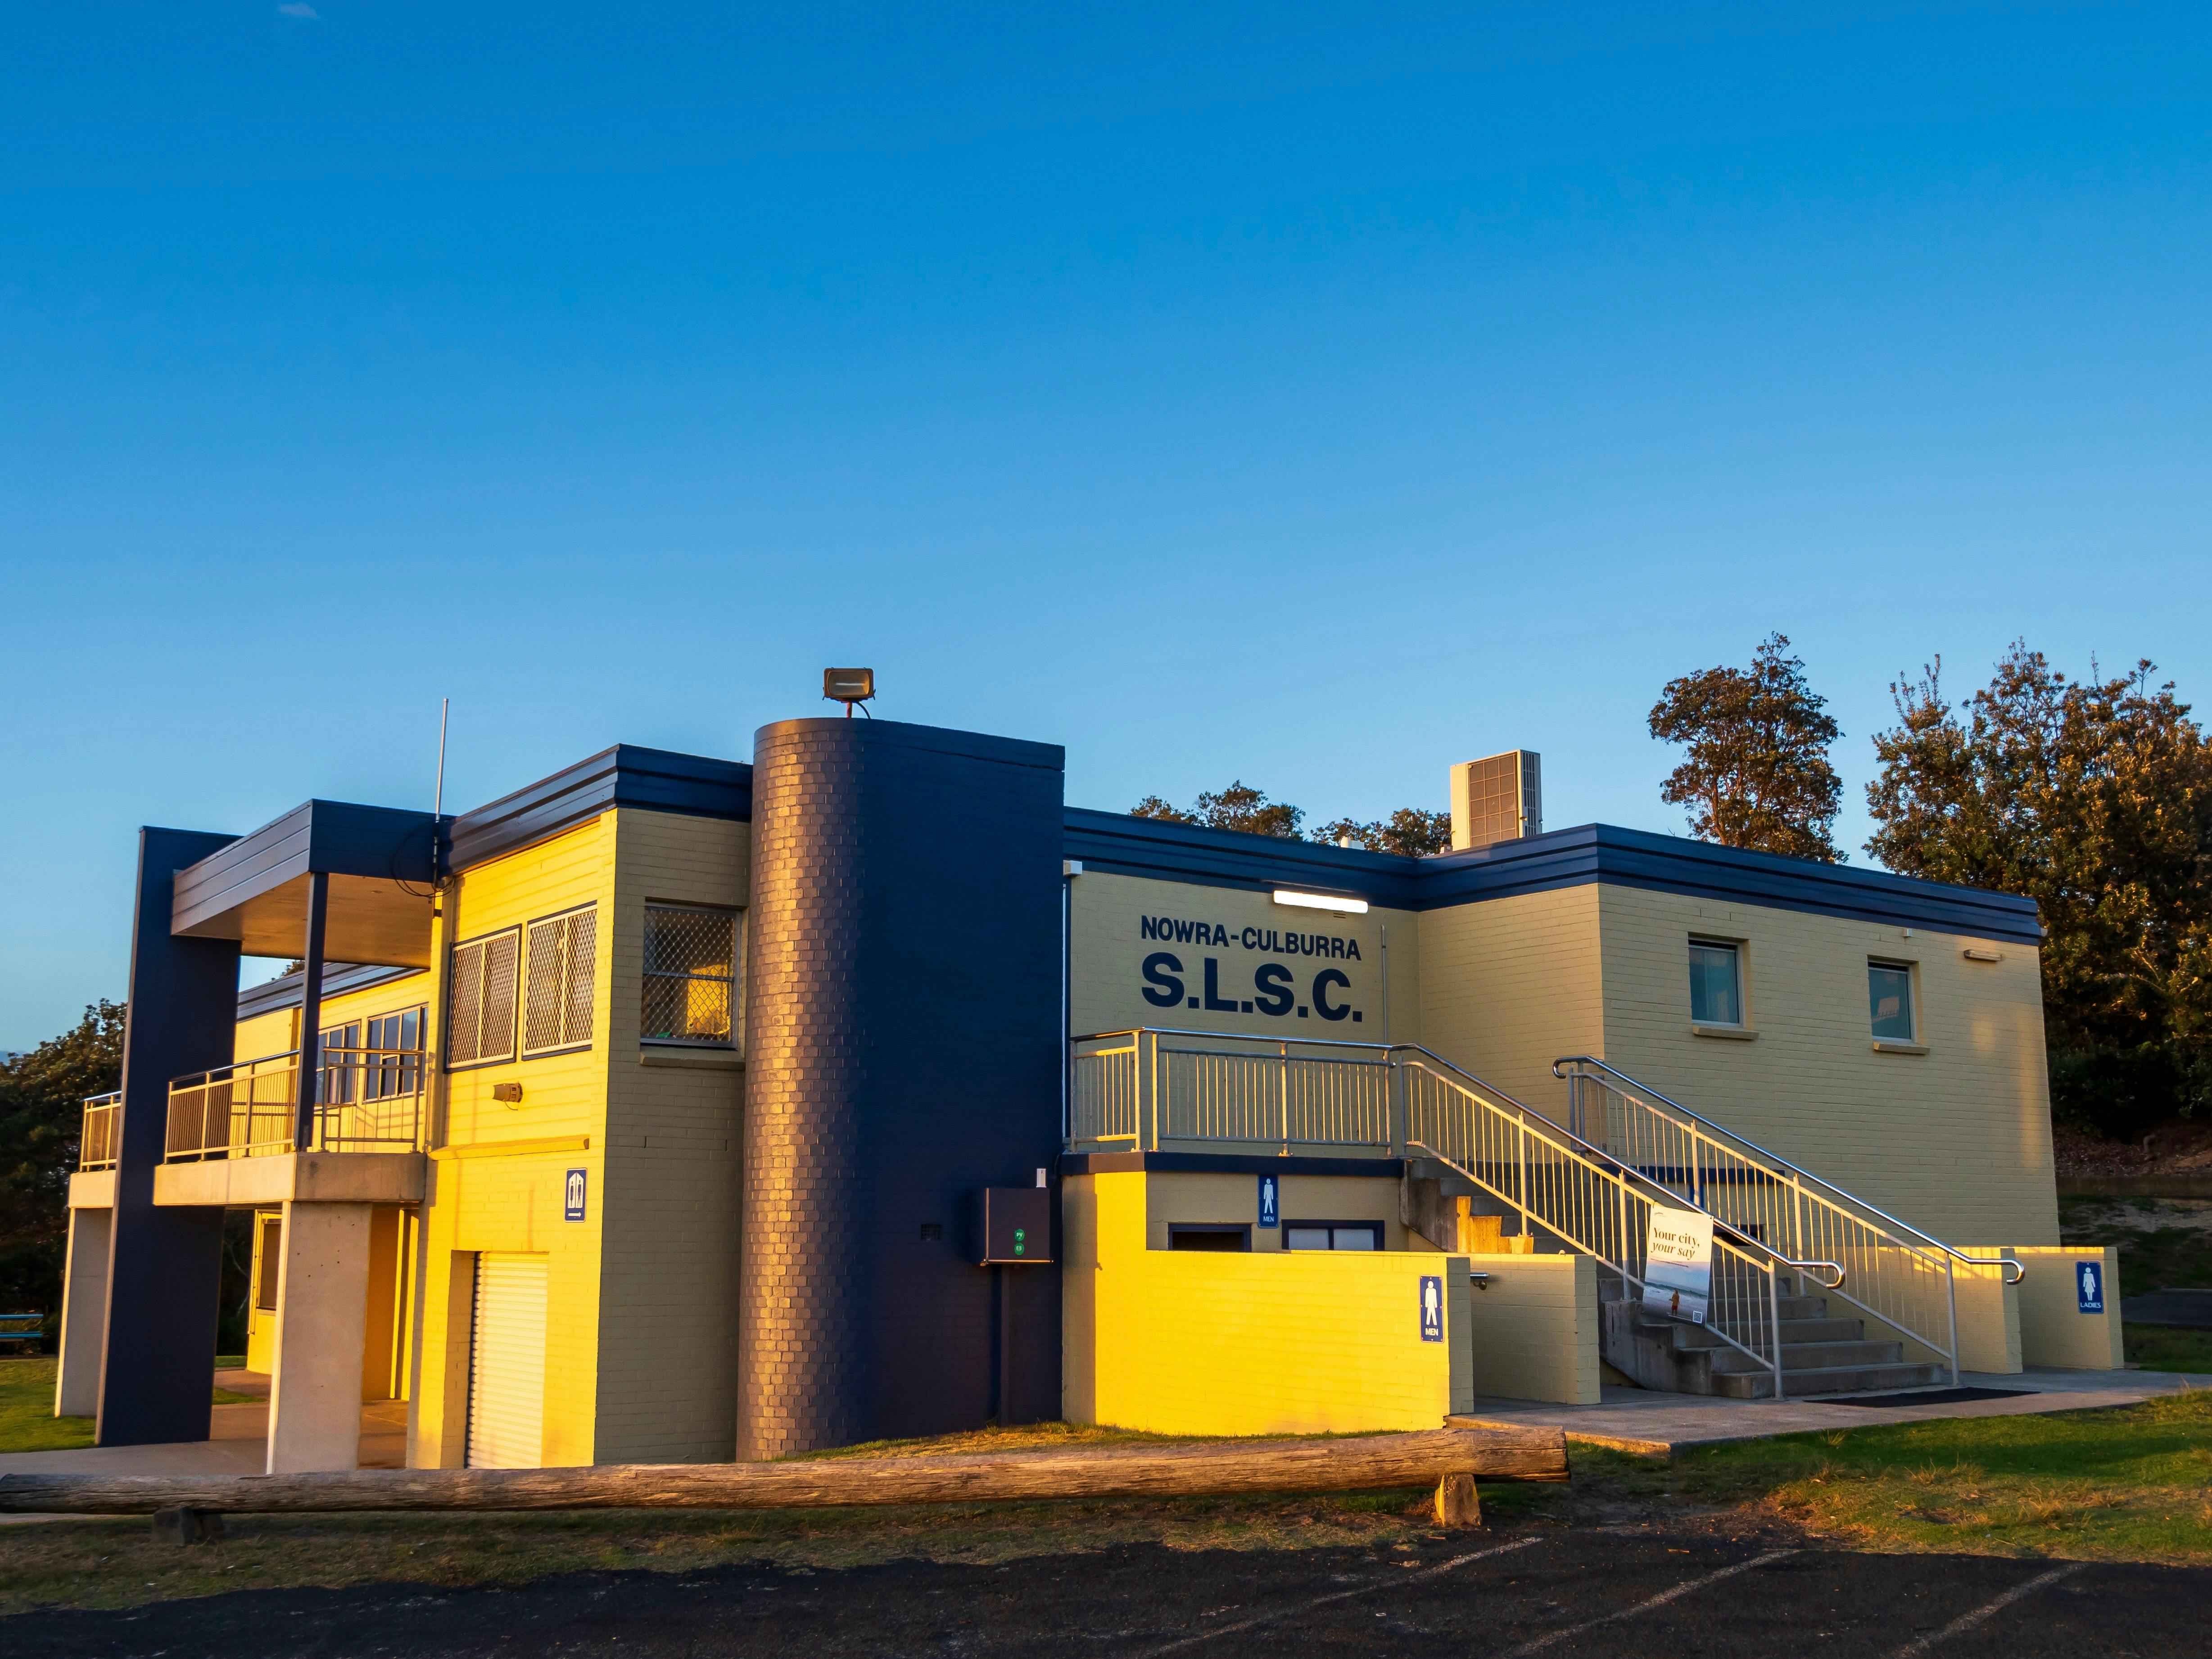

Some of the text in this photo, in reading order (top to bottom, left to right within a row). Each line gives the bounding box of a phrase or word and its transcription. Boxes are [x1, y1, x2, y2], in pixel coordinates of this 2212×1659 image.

[1141, 915, 1362, 961] NOWRA-CULBURRA
[1141, 952, 1363, 1022] S.L.S.C.
[1654, 1227, 1700, 1248] Your city,
[1651, 1242, 1695, 1260] your say
[1425, 1328, 1438, 1336] MEN
